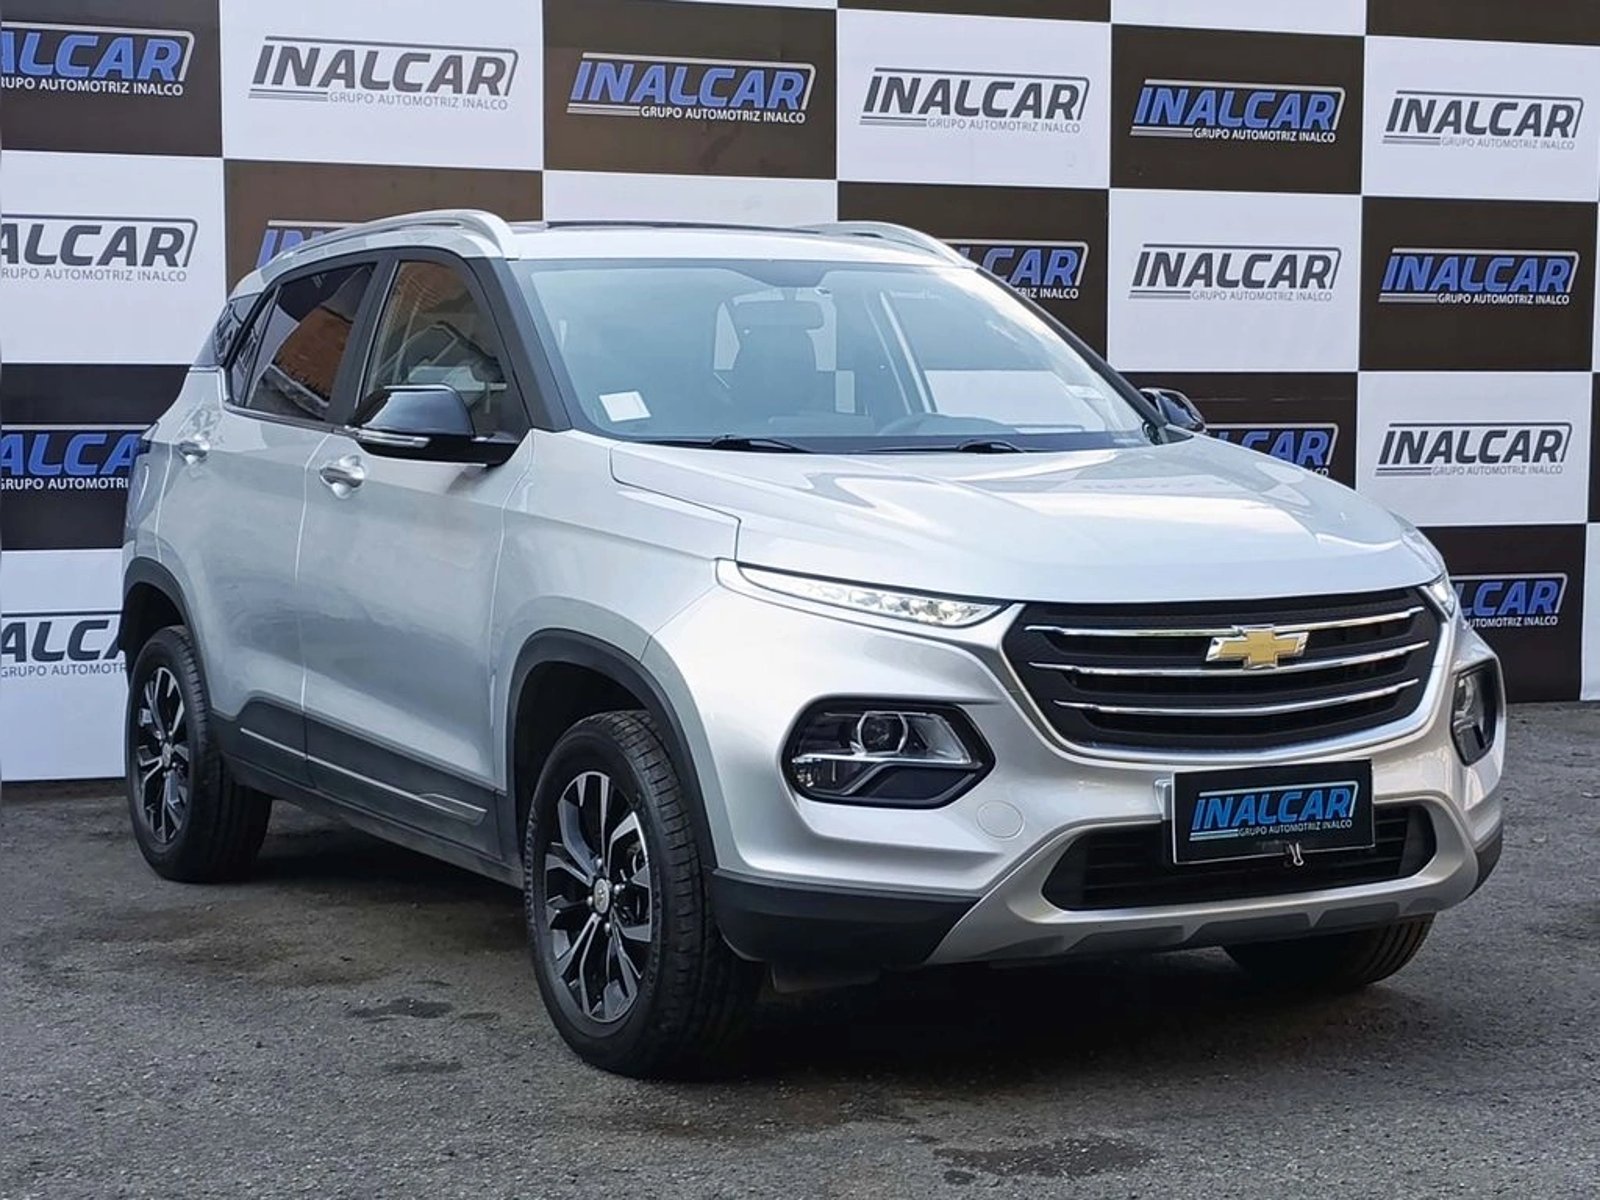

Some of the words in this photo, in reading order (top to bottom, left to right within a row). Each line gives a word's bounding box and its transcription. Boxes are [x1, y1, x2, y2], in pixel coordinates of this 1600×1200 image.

[252, 45, 507, 96] INALCAR
[39, 79, 130, 94] AUTOMOTRIZ
[134, 83, 184, 96] INALCO
[570, 61, 805, 110] INALCAR
[330, 91, 374, 104] GRUPO
[378, 93, 459, 108] AUTOMOTRIZ
[462, 96, 508, 110] INALCO
[863, 76, 1079, 120] INALCAR
[641, 106, 682, 118] GRUPO
[685, 108, 760, 122] AUTOMOTRIZ
[763, 110, 806, 124] INALCO
[1134, 87, 1336, 130] INALCAR
[927, 119, 967, 129] GRUPO
[968, 120, 1038, 132] AUTOMOTRIZ
[1041, 123, 1081, 134] INALCO
[1385, 98, 1574, 138] INALCAR
[1194, 128, 1230, 140] GRUPO
[1232, 130, 1296, 142] AUTOMOTRIZ
[1299, 132, 1336, 143] INALCO
[1441, 137, 1475, 147] GRUPO
[1477, 138, 1538, 150] AUTOMOTRIZ
[1540, 140, 1576, 150] INALCO
[44, 268, 134, 282] AUTOMOTRIZ
[137, 270, 187, 282] INALCO
[960, 248, 1078, 286] CAR
[1132, 251, 1332, 289] INALCAR
[1382, 255, 1571, 293] INALCAR
[1040, 288, 1079, 300] INALCO
[1192, 290, 1227, 300] GRUPO
[1229, 291, 1294, 301] AUTOMOTRIZ
[1296, 292, 1332, 302] INALCO
[1438, 293, 1471, 304] GRUPO
[1473, 294, 1534, 304] AUTOMOTRIZ
[1536, 294, 1570, 305] INALCO
[1378, 430, 1563, 465] INALCAR
[1432, 466, 1465, 476] GRUPO
[1467, 465, 1527, 476] AUTOMOTRIZ
[1528, 465, 1563, 475] INALCO
[1524, 616, 1558, 626] INALCO
[1191, 788, 1351, 831] INALCAR
[1239, 826, 1268, 836] GRUPO
[1268, 822, 1320, 834] AUTOMOTRIZ
[1322, 819, 1352, 830] INALCO
